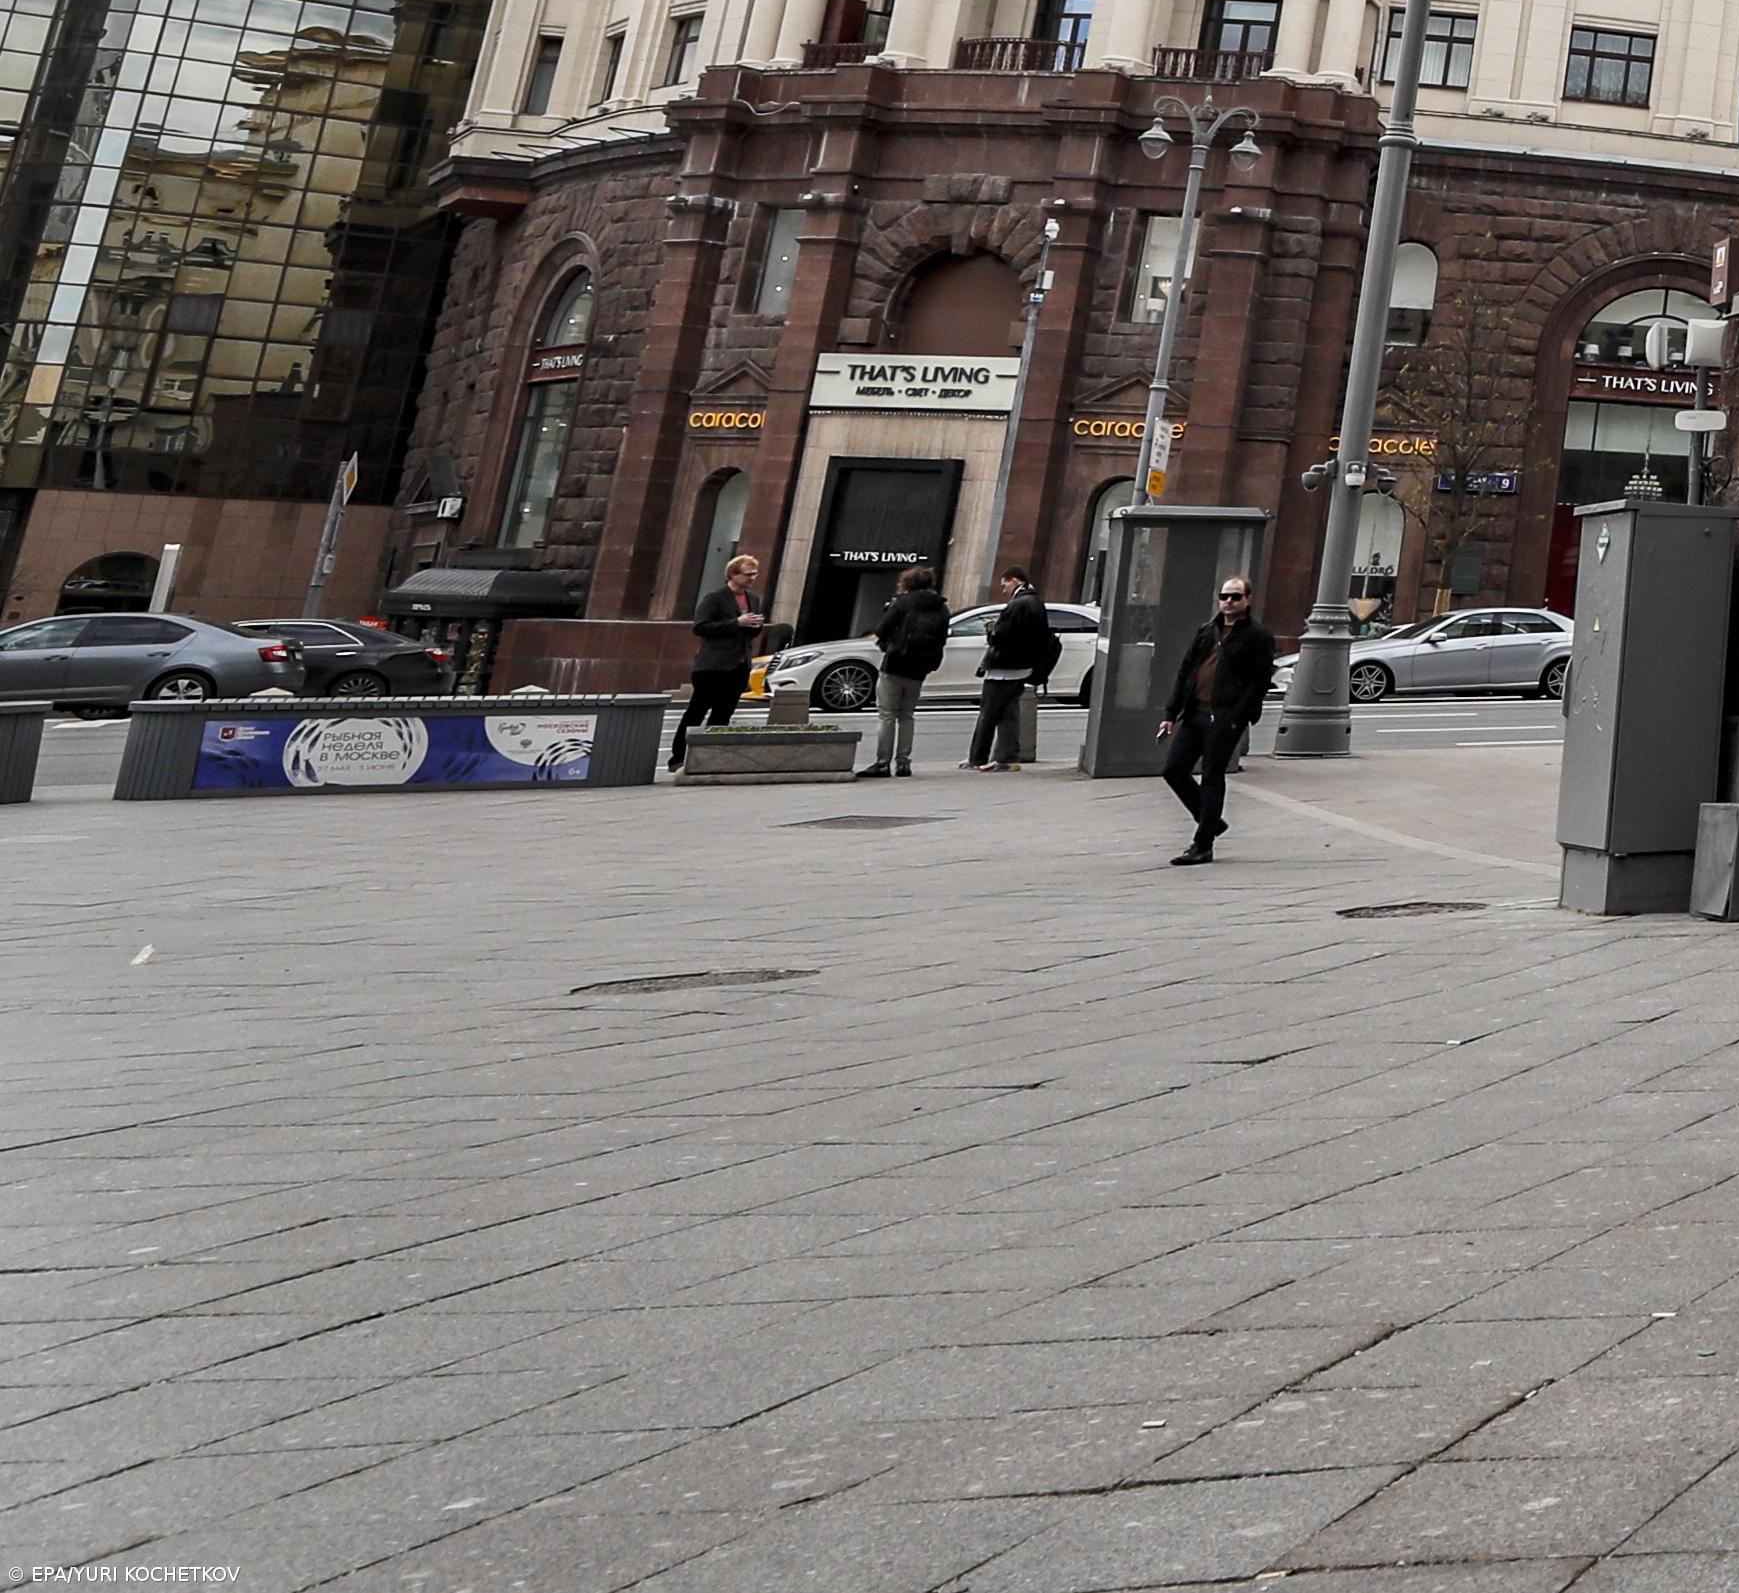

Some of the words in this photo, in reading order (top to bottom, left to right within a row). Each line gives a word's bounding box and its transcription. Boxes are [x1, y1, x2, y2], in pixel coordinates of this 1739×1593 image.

[848, 364, 917, 382] THAT'S
[921, 366, 990, 385] LIVING
[904, 387, 930, 397] СВЕТ
[1602, 375, 1657, 392] THAT'S
[1660, 379, 1714, 396] LIVIN
[689, 410, 767, 428] caracol
[1074, 420, 1184, 439] carace
[1501, 478, 1510, 489] 9
[843, 551, 879, 562] THAT'S
[881, 552, 917, 563] LIVING
[320, 752, 328, 761] В
